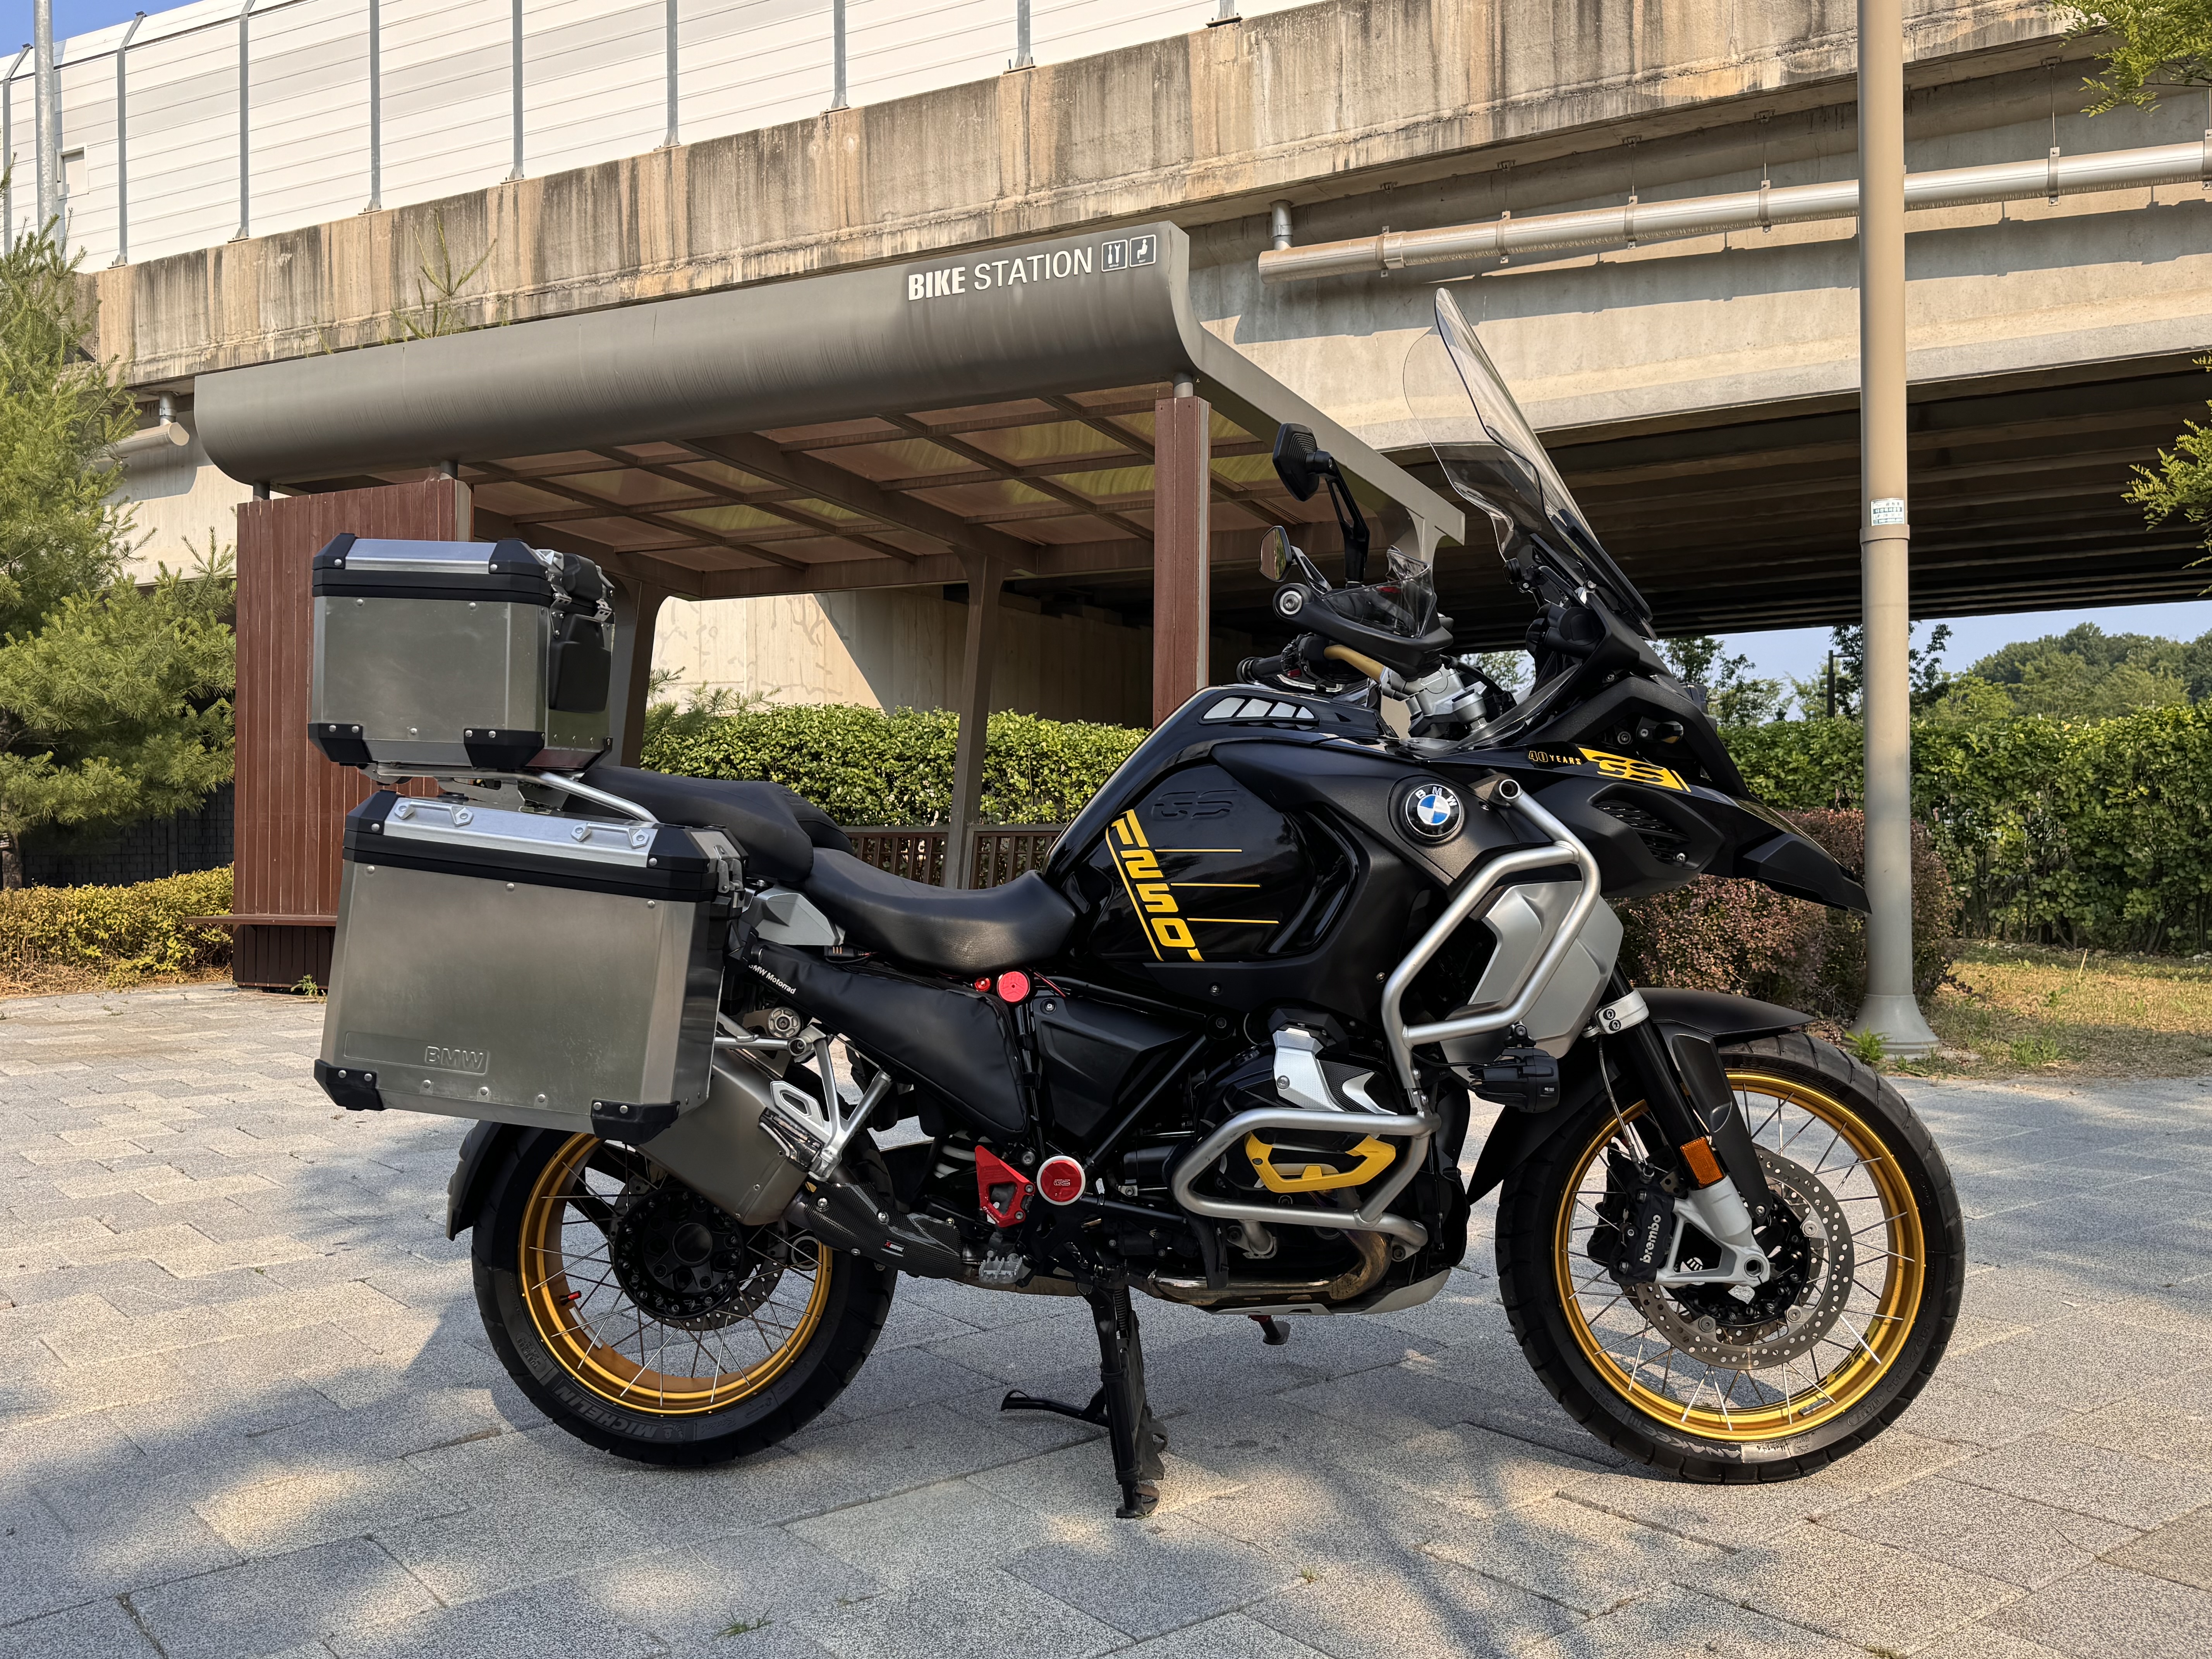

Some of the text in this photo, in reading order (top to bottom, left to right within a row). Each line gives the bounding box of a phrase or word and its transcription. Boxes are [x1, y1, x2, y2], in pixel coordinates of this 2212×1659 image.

[908, 246, 1092, 301] BIKE STATION
[1528, 750, 1582, 765] 40 YEARS
[1591, 756, 1665, 783] GS
[1152, 789, 1238, 818] GS
[1415, 786, 1458, 806] BMW
[1111, 809, 1196, 948] 1250
[766, 972, 797, 994] Motorrad
[424, 1046, 484, 1070] BMW
[1639, 1214, 1661, 1264] brembo
[553, 1386, 656, 1438] MICHELIN
[1629, 1415, 1741, 1458] ANAKEE III
